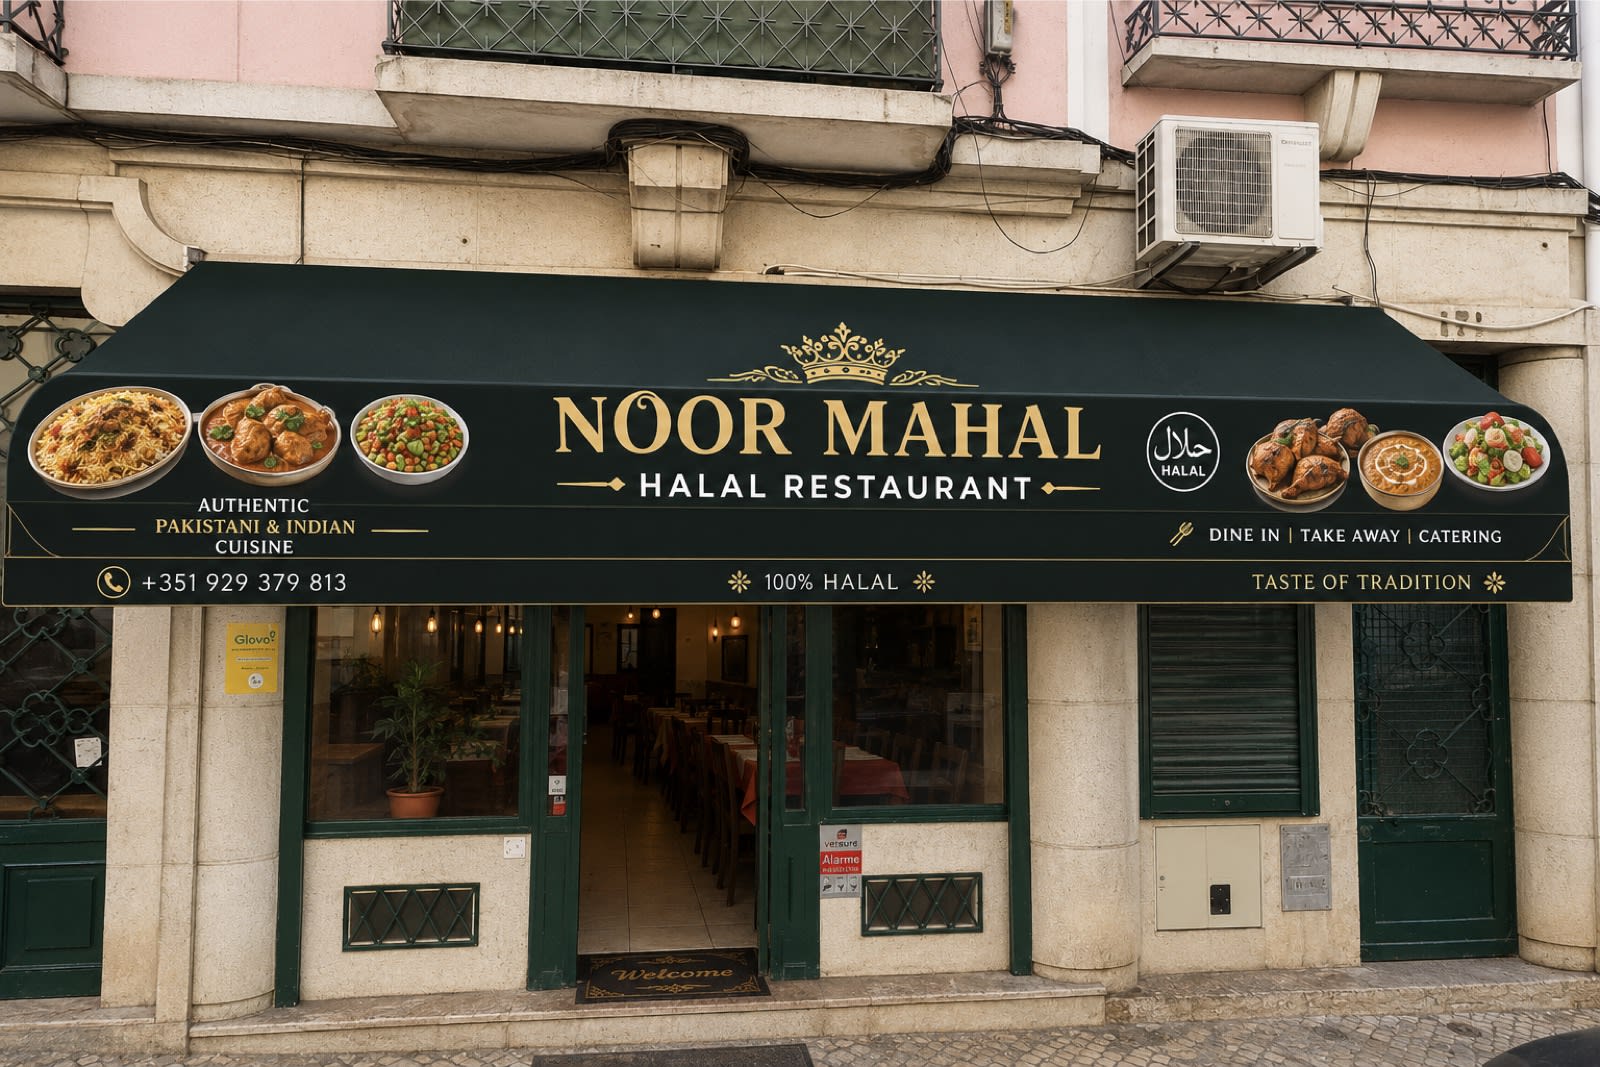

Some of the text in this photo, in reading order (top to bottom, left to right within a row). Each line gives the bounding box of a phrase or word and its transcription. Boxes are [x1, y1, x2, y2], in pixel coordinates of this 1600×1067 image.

[553, 390, 1102, 460] NOOR MAHAL
[1153, 425, 1213, 461] حلال
[1161, 464, 1206, 477] HALAL
[640, 472, 1032, 500] HALAL RESTAURANT
[197, 497, 309, 513] AUTHENTIC
[156, 518, 355, 535] PAKISTANI & INDIAN
[1209, 527, 1502, 544] DINE IN TAKE AWAY CATERING
[215, 539, 294, 555] CUISINE
[142, 573, 346, 592] +351 929 379 813
[764, 573, 899, 591] 100% HALAL
[1251, 573, 1471, 590] TASTE OF TRADITION
[234, 634, 270, 645] Glovo
[611, 968, 733, 980] Welcome
